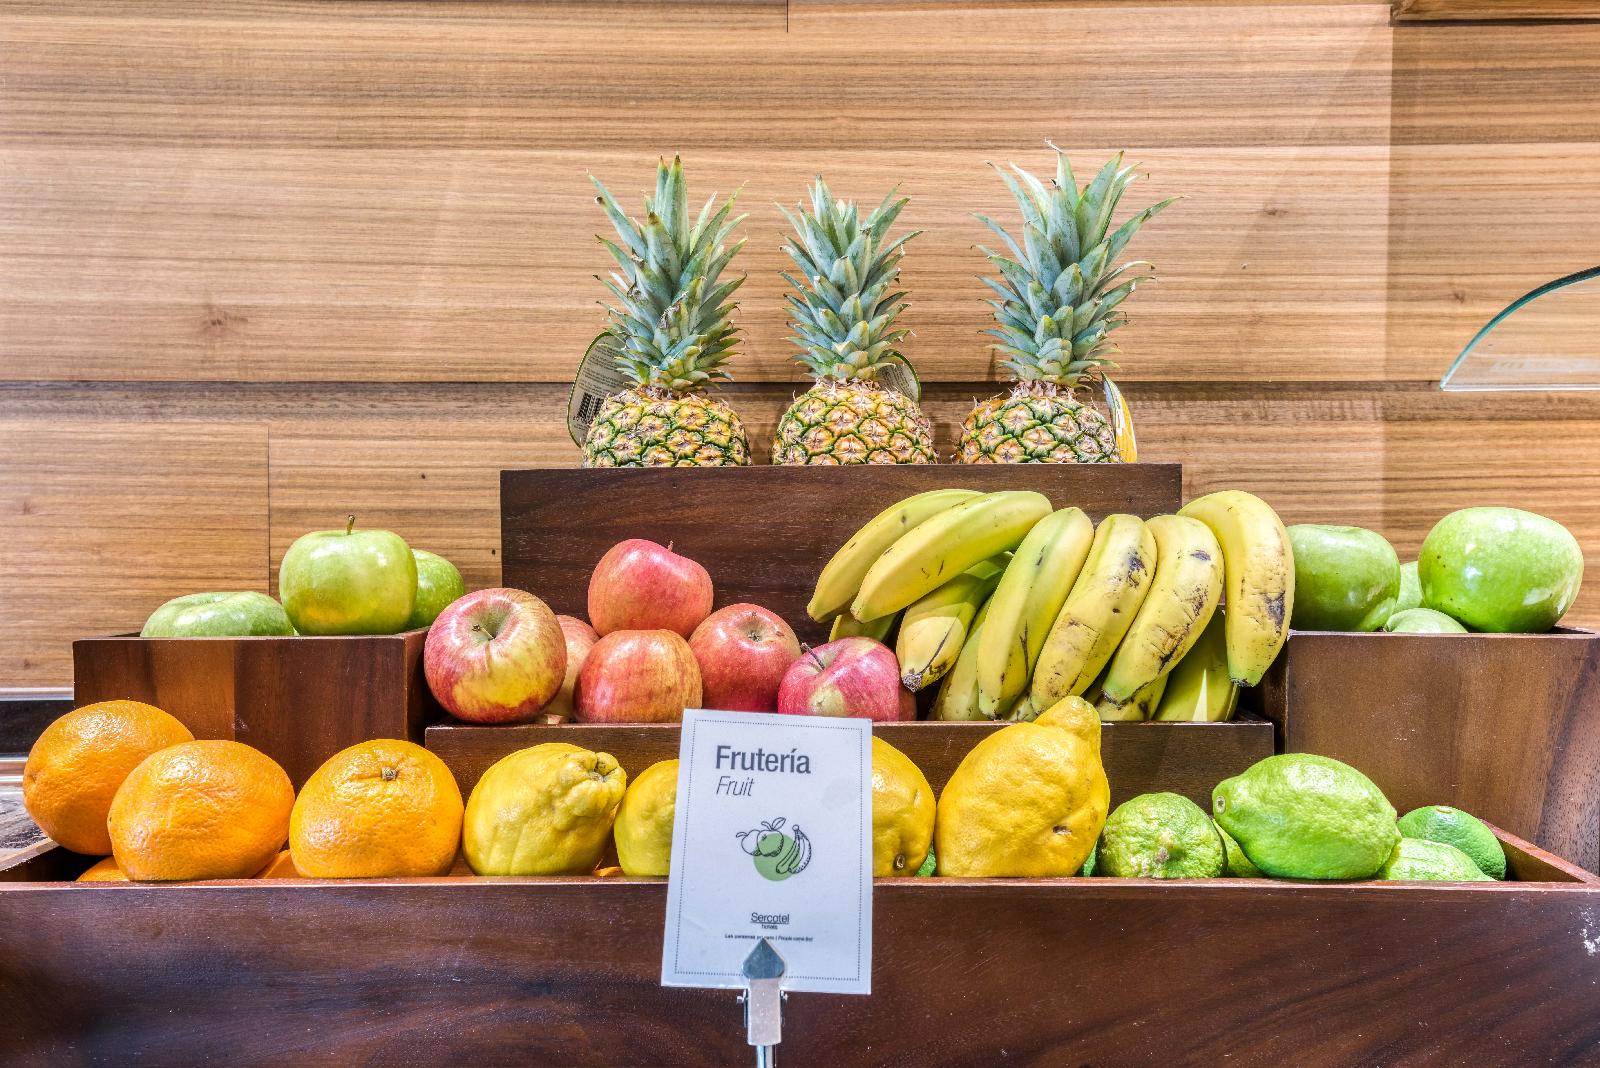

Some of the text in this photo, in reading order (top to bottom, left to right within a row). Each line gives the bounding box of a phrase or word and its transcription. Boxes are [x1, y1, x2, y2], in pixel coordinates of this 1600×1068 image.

[715, 744, 811, 774] Frutería
[715, 776, 755, 797] Fruit
[750, 911, 790, 925] Sercotel
